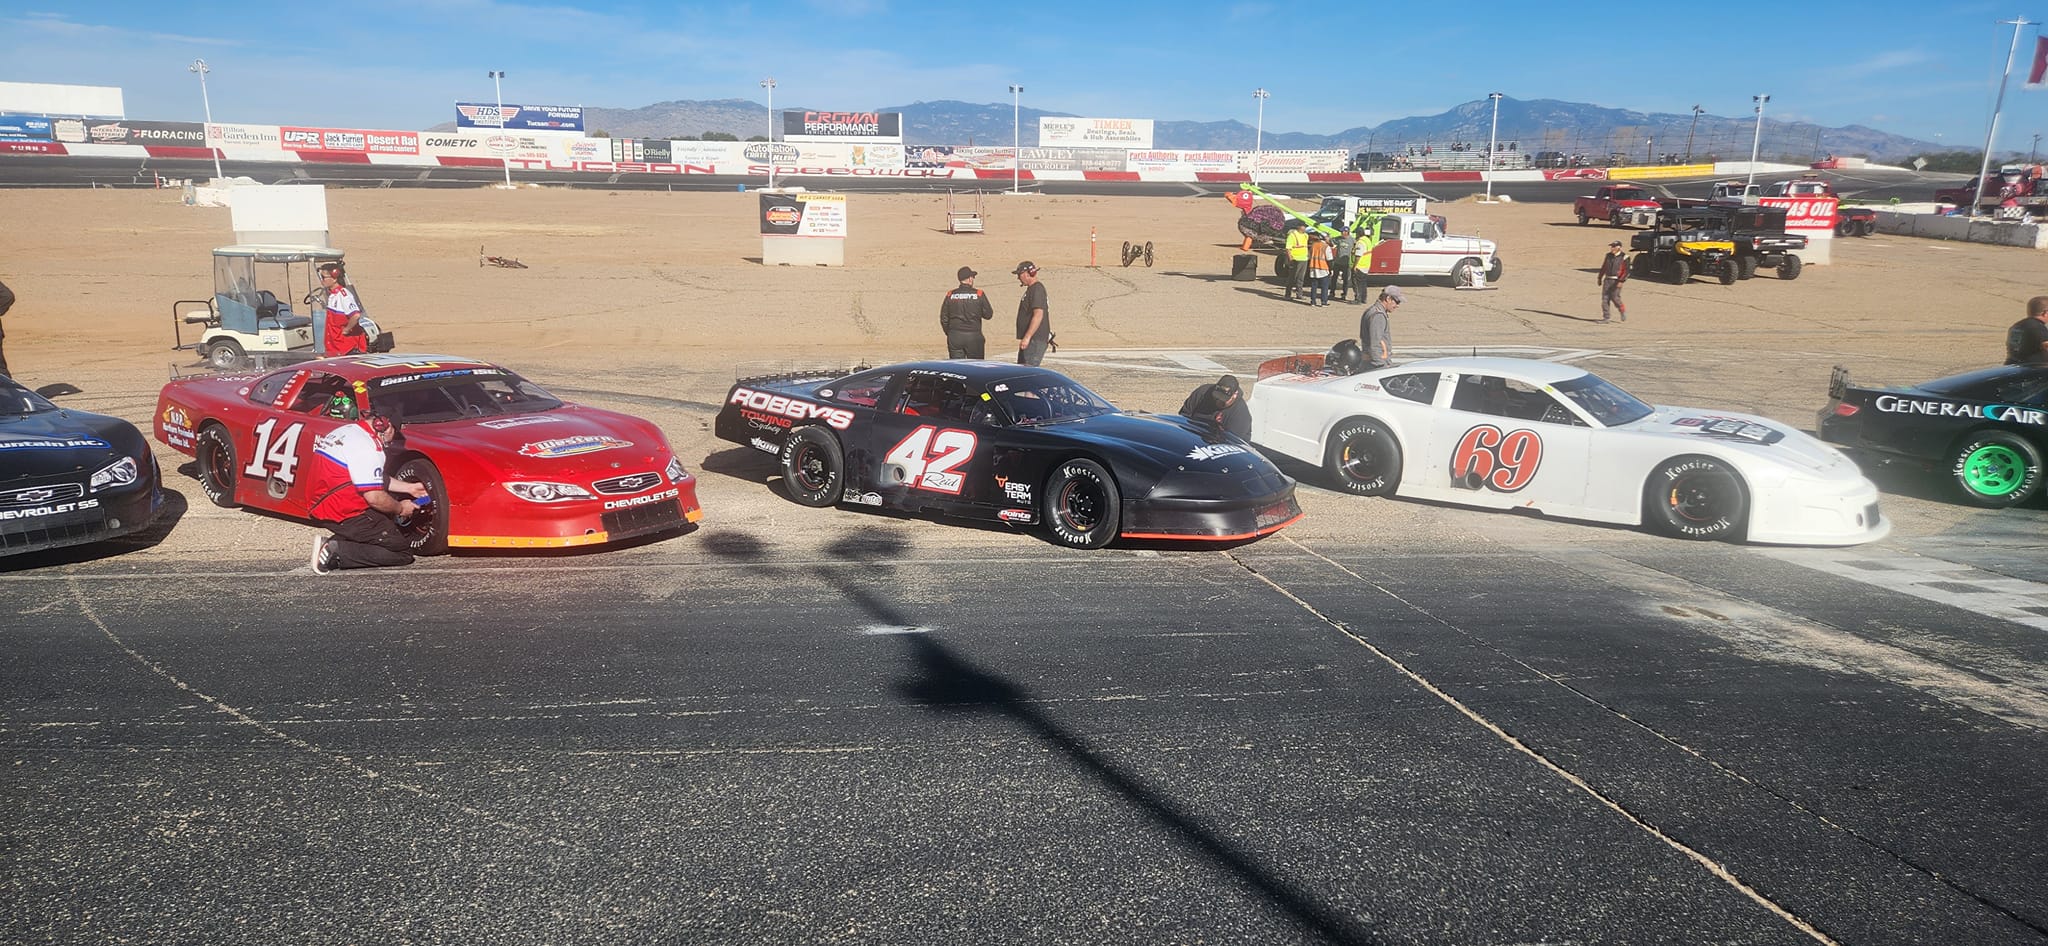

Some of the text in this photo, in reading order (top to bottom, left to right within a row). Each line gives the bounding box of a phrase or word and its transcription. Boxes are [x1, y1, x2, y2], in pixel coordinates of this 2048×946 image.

[477, 107, 501, 116] HDS
[804, 111, 879, 124] CROWN
[805, 123, 879, 131] PERFORMANCE
[1093, 120, 1132, 129] TIMKEN
[140, 129, 204, 141] FLORACING
[223, 132, 258, 140] Garden
[284, 131, 320, 143] UPR
[326, 134, 340, 143] Jack
[367, 135, 417, 146] Desert Rat
[426, 137, 478, 148] COMETIC
[746, 144, 796, 152] AutoNation
[1019, 148, 1075, 159] LAWLEY
[1130, 152, 1178, 160] Parts Authority
[1184, 152, 1233, 161] Parts Authority
[1255, 154, 1307, 167] Simmons
[510, 159, 715, 174] TUCSON
[748, 165, 955, 177] Speedway
[1810, 202, 1834, 216] OIL
[731, 387, 855, 429] ROBBY'S
[1875, 395, 1984, 419] GENERAL
[740, 409, 792, 428] TOWING
[1339, 426, 1377, 443] Hoosier
[537, 435, 615, 450] Western
[245, 417, 304, 484] 14
[782, 435, 803, 468] Hoosier
[885, 425, 977, 494] 42
[1450, 424, 1543, 492] 69
[1953, 441, 1981, 477] Hoosier
[1063, 466, 1100, 483] Hoosier
[1665, 459, 1715, 481] Hoosier
[814, 471, 836, 501] Hoosier
[923, 471, 958, 488] Reid
[1347, 476, 1385, 492] Hoosier
[2009, 465, 2038, 500] Hoosier
[1005, 482, 1031, 493] EASY
[604, 488, 679, 510] CHEVROLET SS
[1004, 490, 1032, 500] TERM
[78, 498, 99, 510] SS
[1001, 509, 1032, 519] Pointe
[1681, 517, 1731, 538] Hoosier
[1055, 526, 1092, 545] Hoosier
